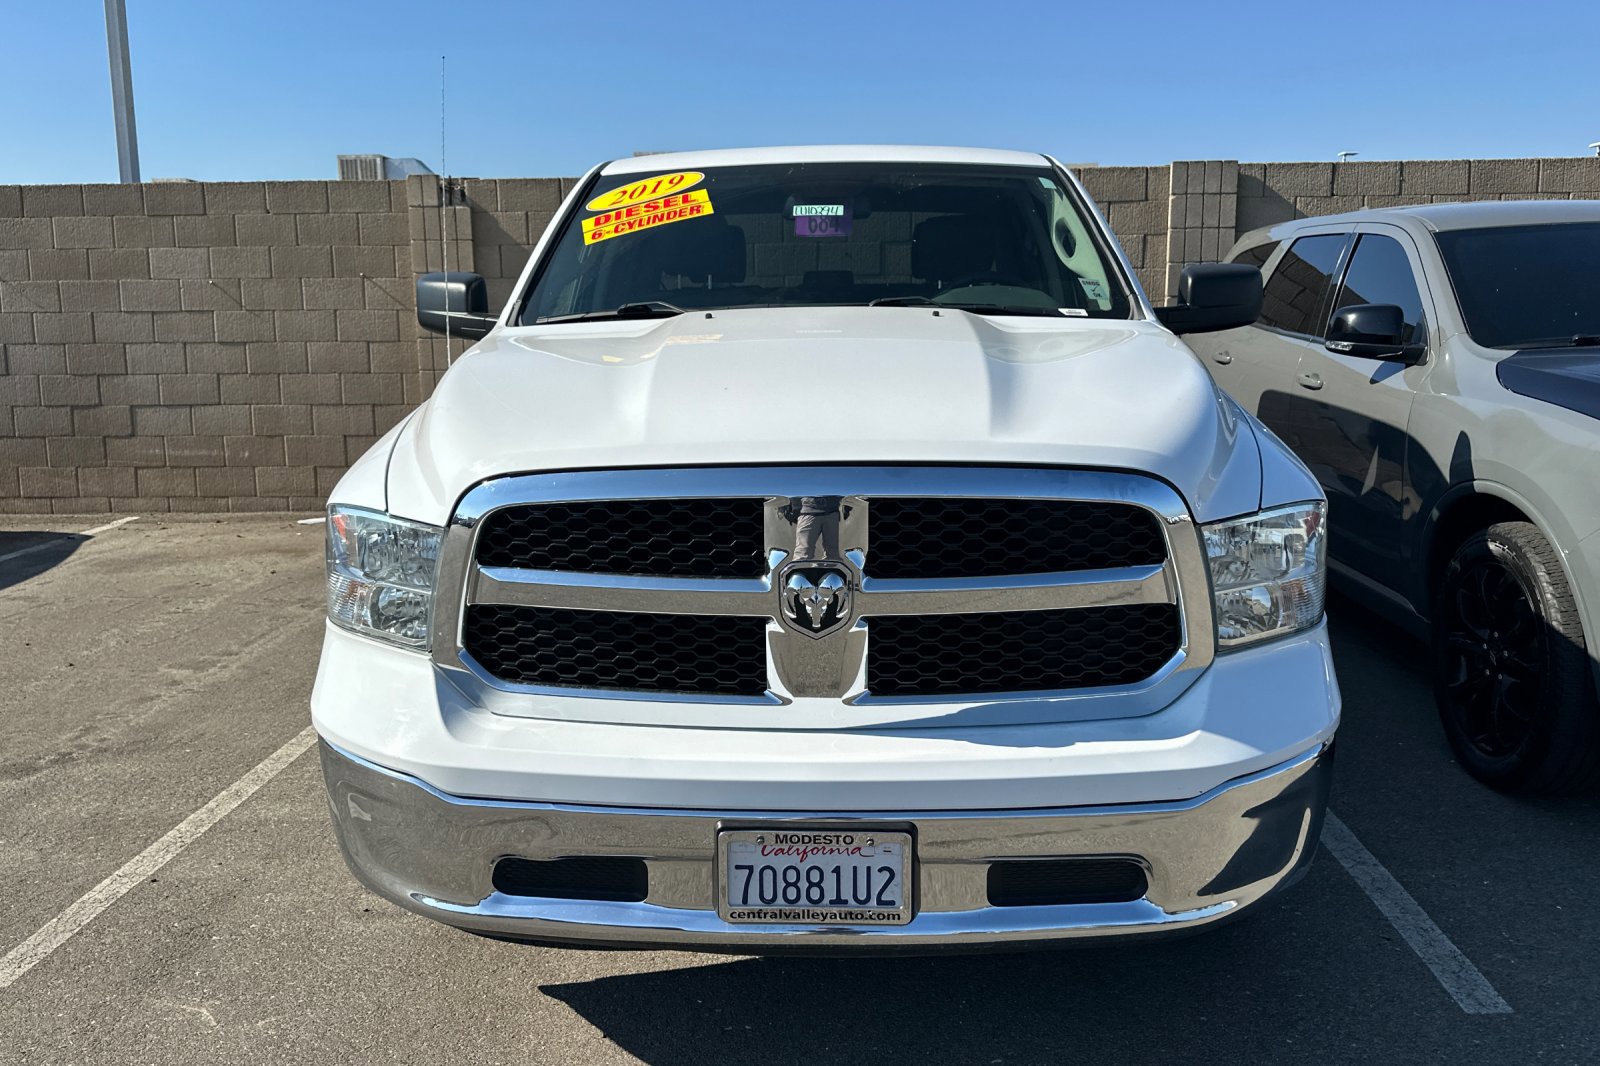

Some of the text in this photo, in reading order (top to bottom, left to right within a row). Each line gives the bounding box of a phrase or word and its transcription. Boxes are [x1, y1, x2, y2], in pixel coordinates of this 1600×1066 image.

[611, 174, 685, 206] 2019
[591, 204, 703, 240] 6-CYLINDER
[594, 193, 697, 227] DIESEL
[761, 845, 875, 862] California
[774, 834, 854, 845] MODESTO
[734, 865, 896, 905] 70881U2
[729, 908, 901, 921] centralvalleyauto.com
